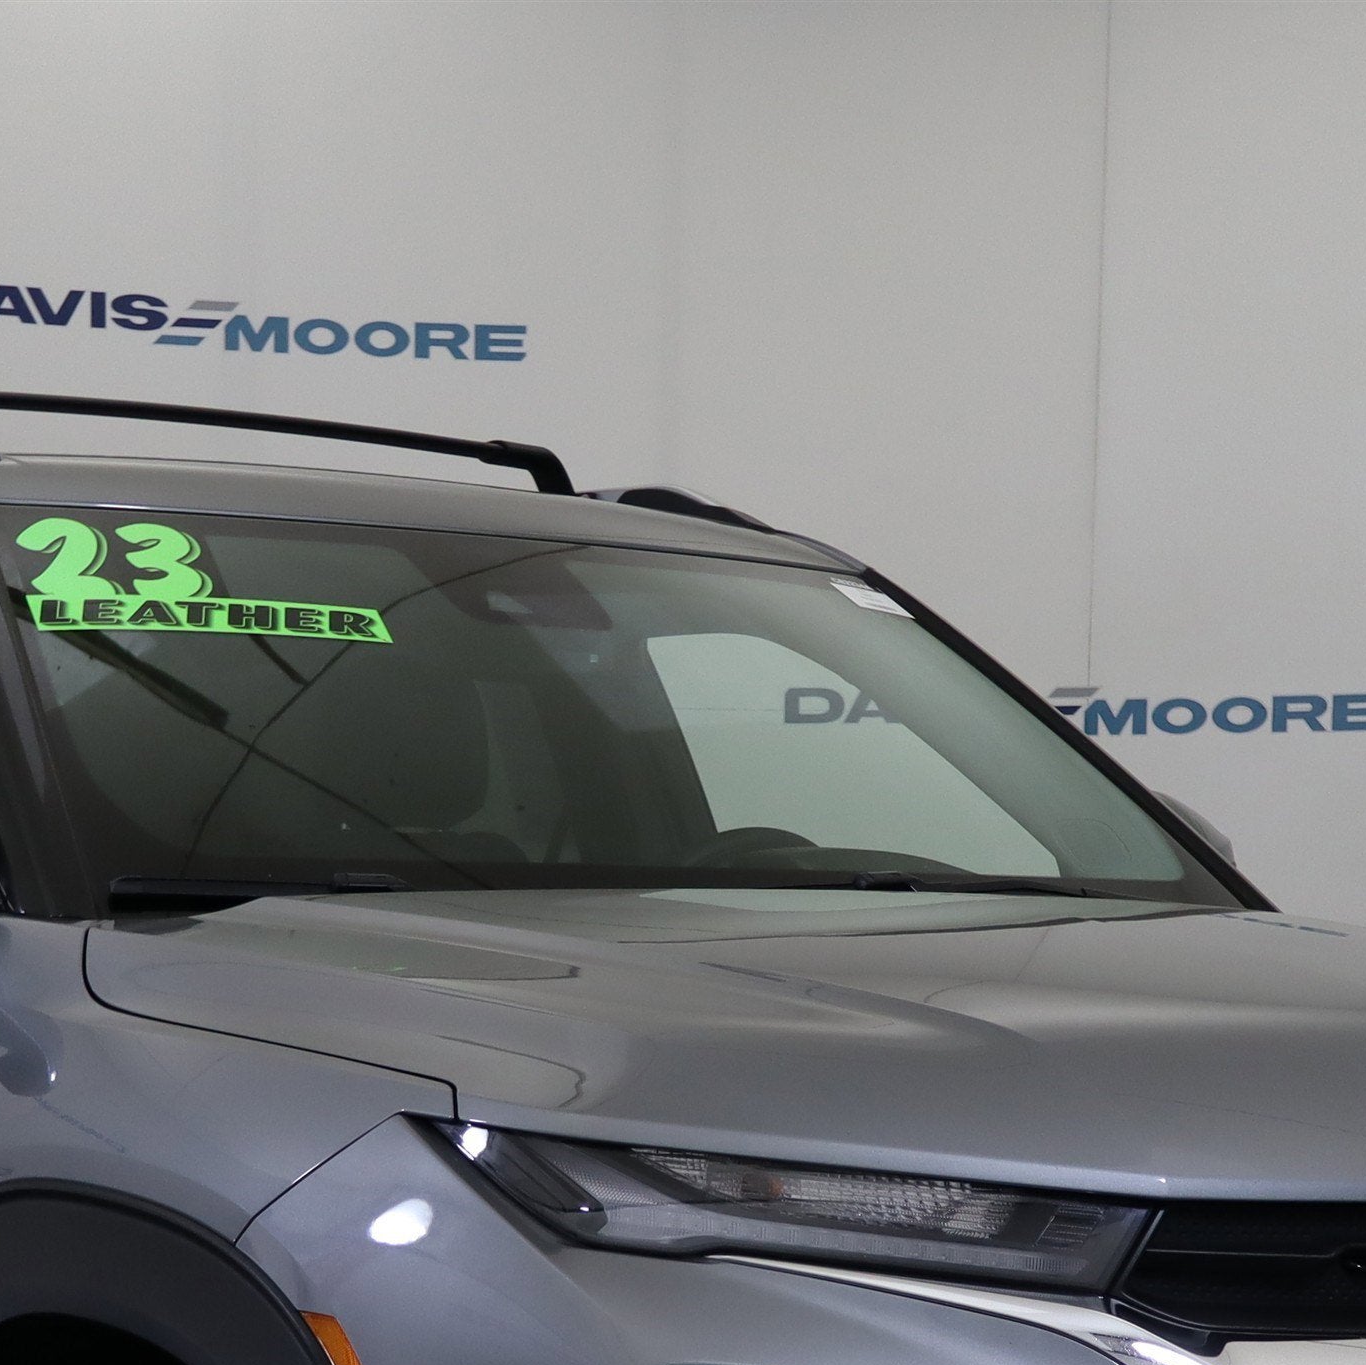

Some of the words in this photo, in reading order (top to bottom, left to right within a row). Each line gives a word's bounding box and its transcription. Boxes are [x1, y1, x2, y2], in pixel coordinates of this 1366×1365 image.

[224, 314, 527, 362] MOORE
[15, 517, 214, 598] 23
[37, 598, 377, 639] LEATHER
